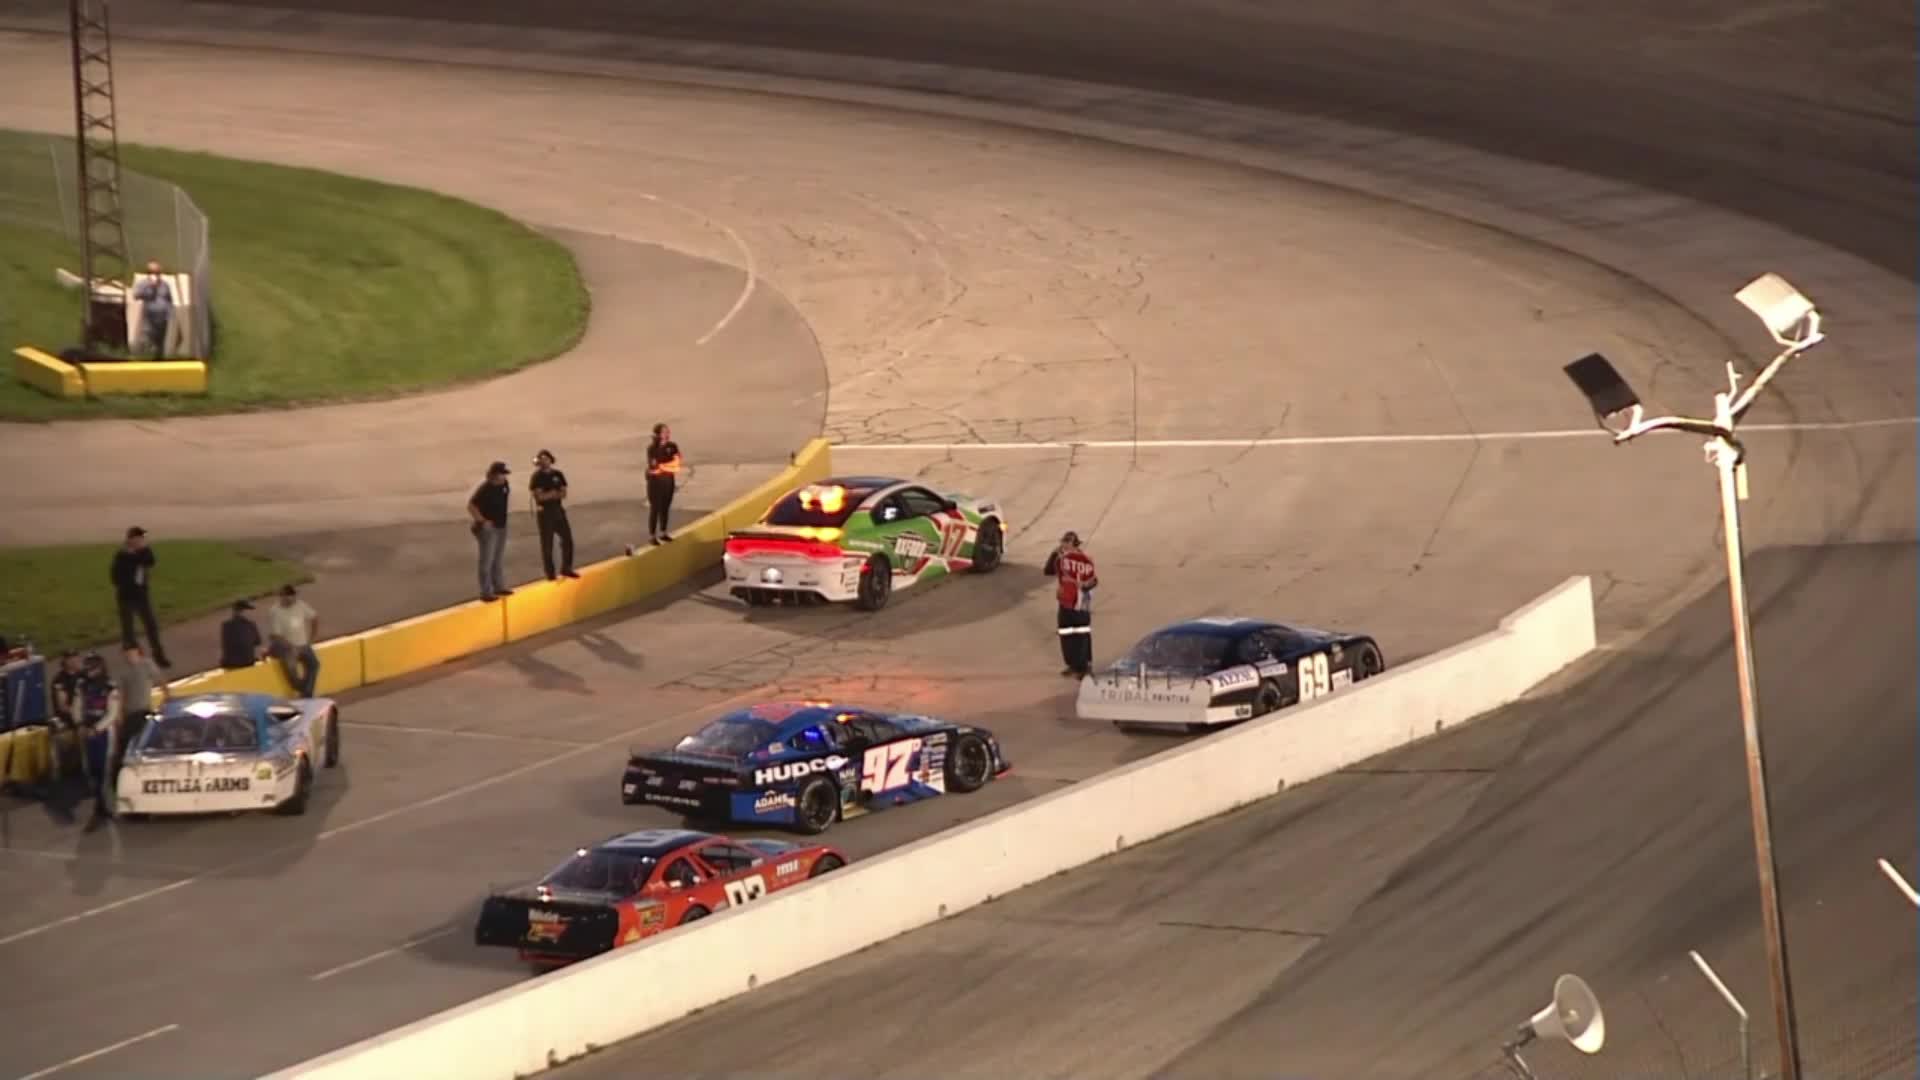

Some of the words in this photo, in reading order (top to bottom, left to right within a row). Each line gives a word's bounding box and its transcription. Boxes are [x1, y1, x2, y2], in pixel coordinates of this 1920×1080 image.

[939, 521, 968, 558] 17
[1062, 557, 1093, 576] STOP
[1298, 651, 1330, 702] 69
[754, 754, 842, 786] HUDCO
[860, 740, 914, 793] 97
